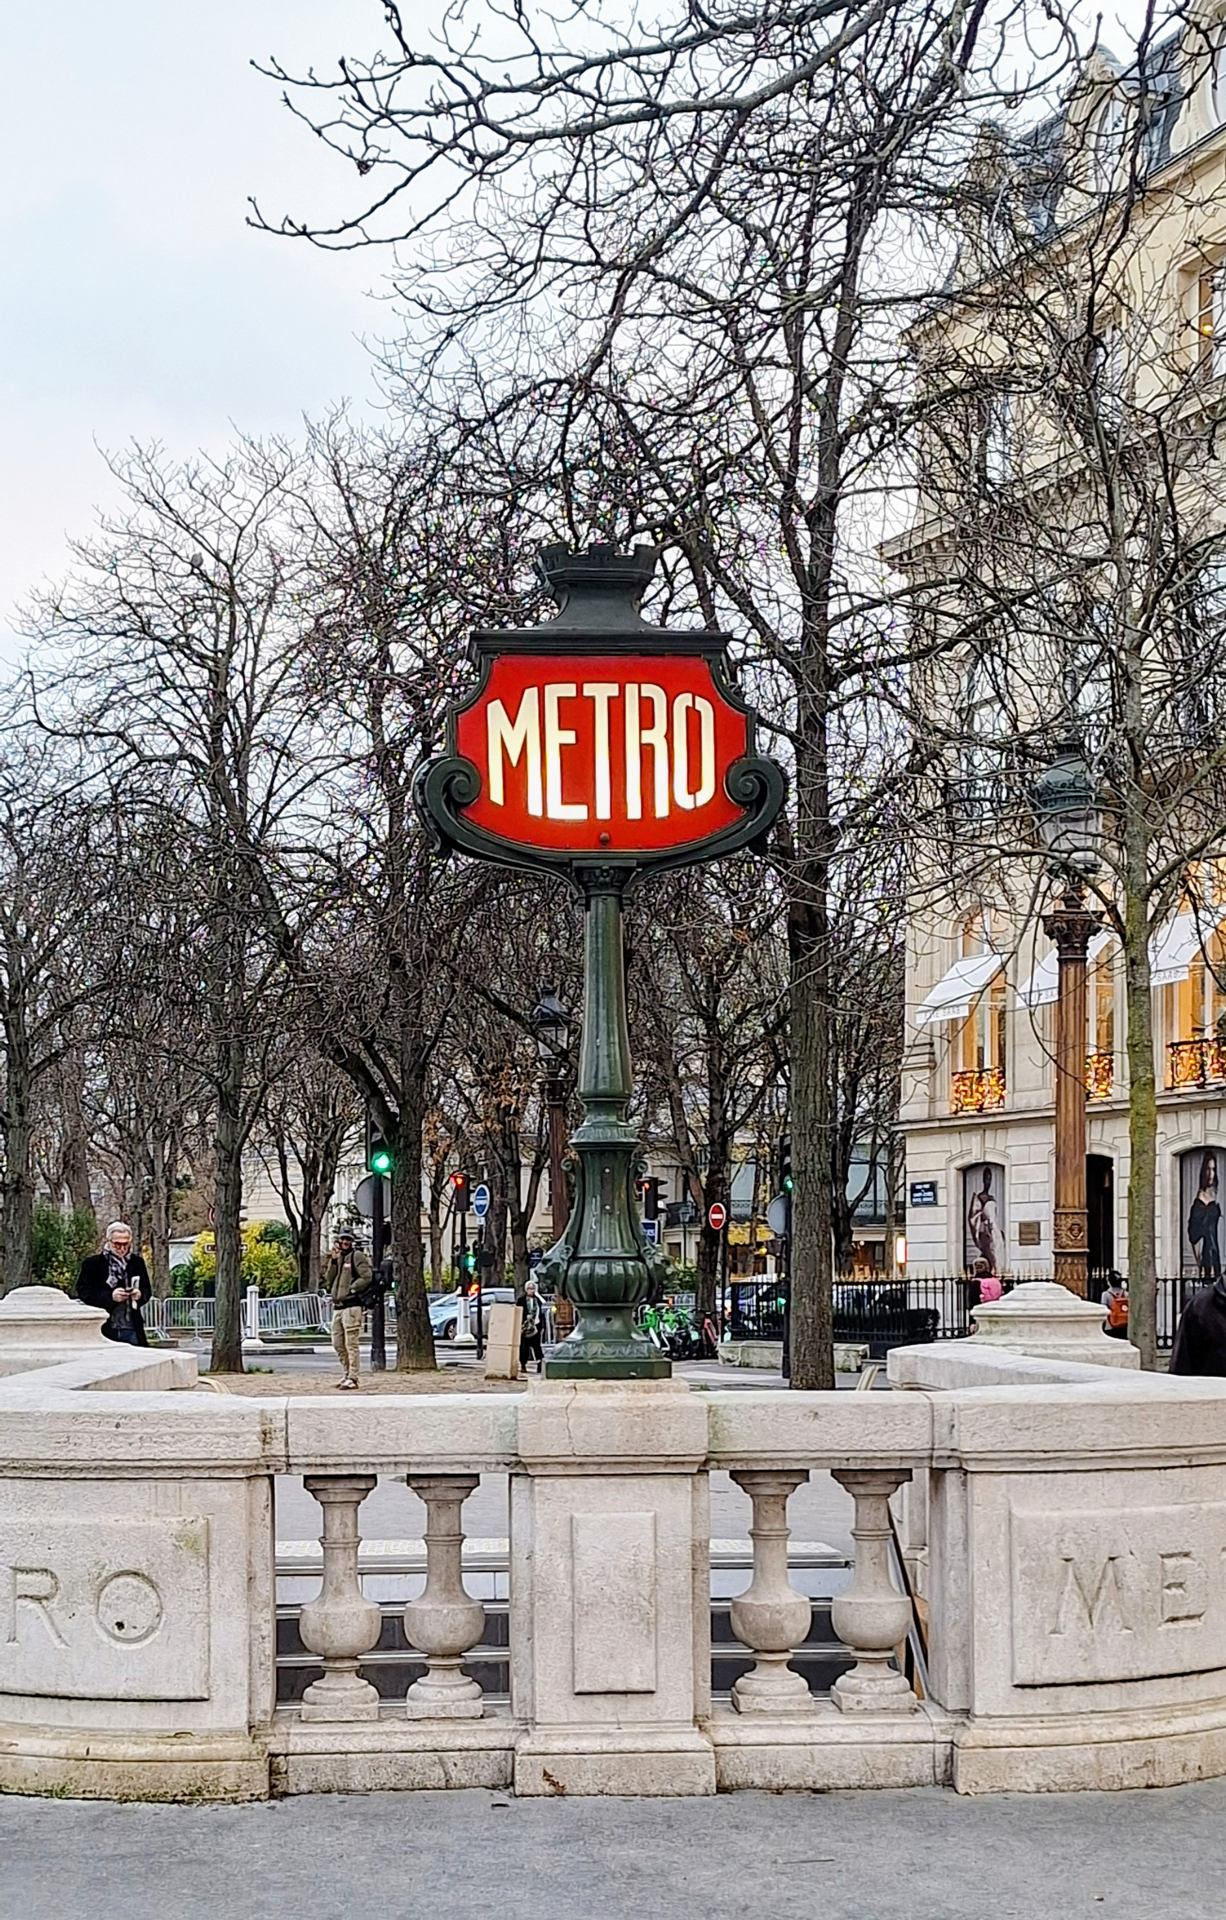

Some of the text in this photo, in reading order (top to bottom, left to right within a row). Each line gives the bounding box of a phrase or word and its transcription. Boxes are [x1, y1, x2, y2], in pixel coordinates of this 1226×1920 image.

[486, 682, 716, 820] METRO
[6, 1565, 165, 1649] RO
[1048, 1546, 1226, 1636] ME
